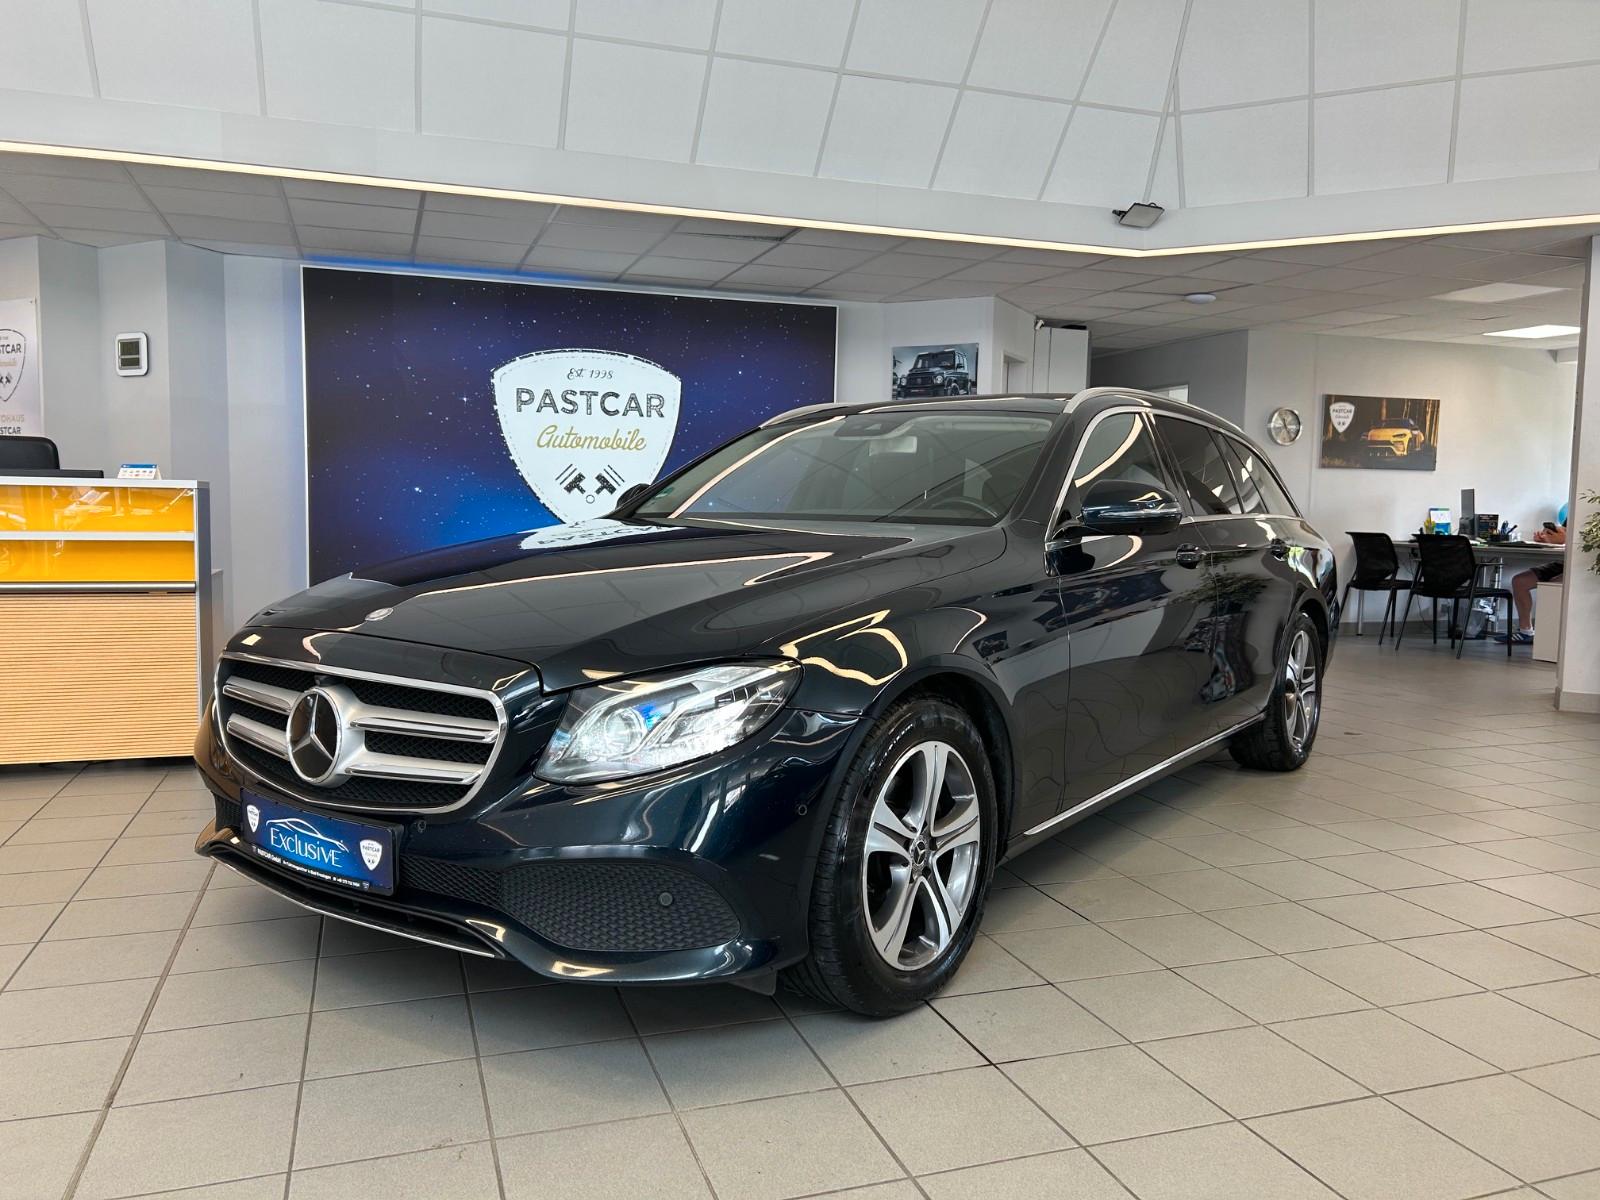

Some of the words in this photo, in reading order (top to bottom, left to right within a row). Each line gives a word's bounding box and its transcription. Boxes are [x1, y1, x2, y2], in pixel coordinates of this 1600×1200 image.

[0, 343, 22, 354] TCAR
[589, 370, 613, 380] 1998
[516, 387, 664, 418] PASTCAR
[536, 424, 646, 451] Automobile
